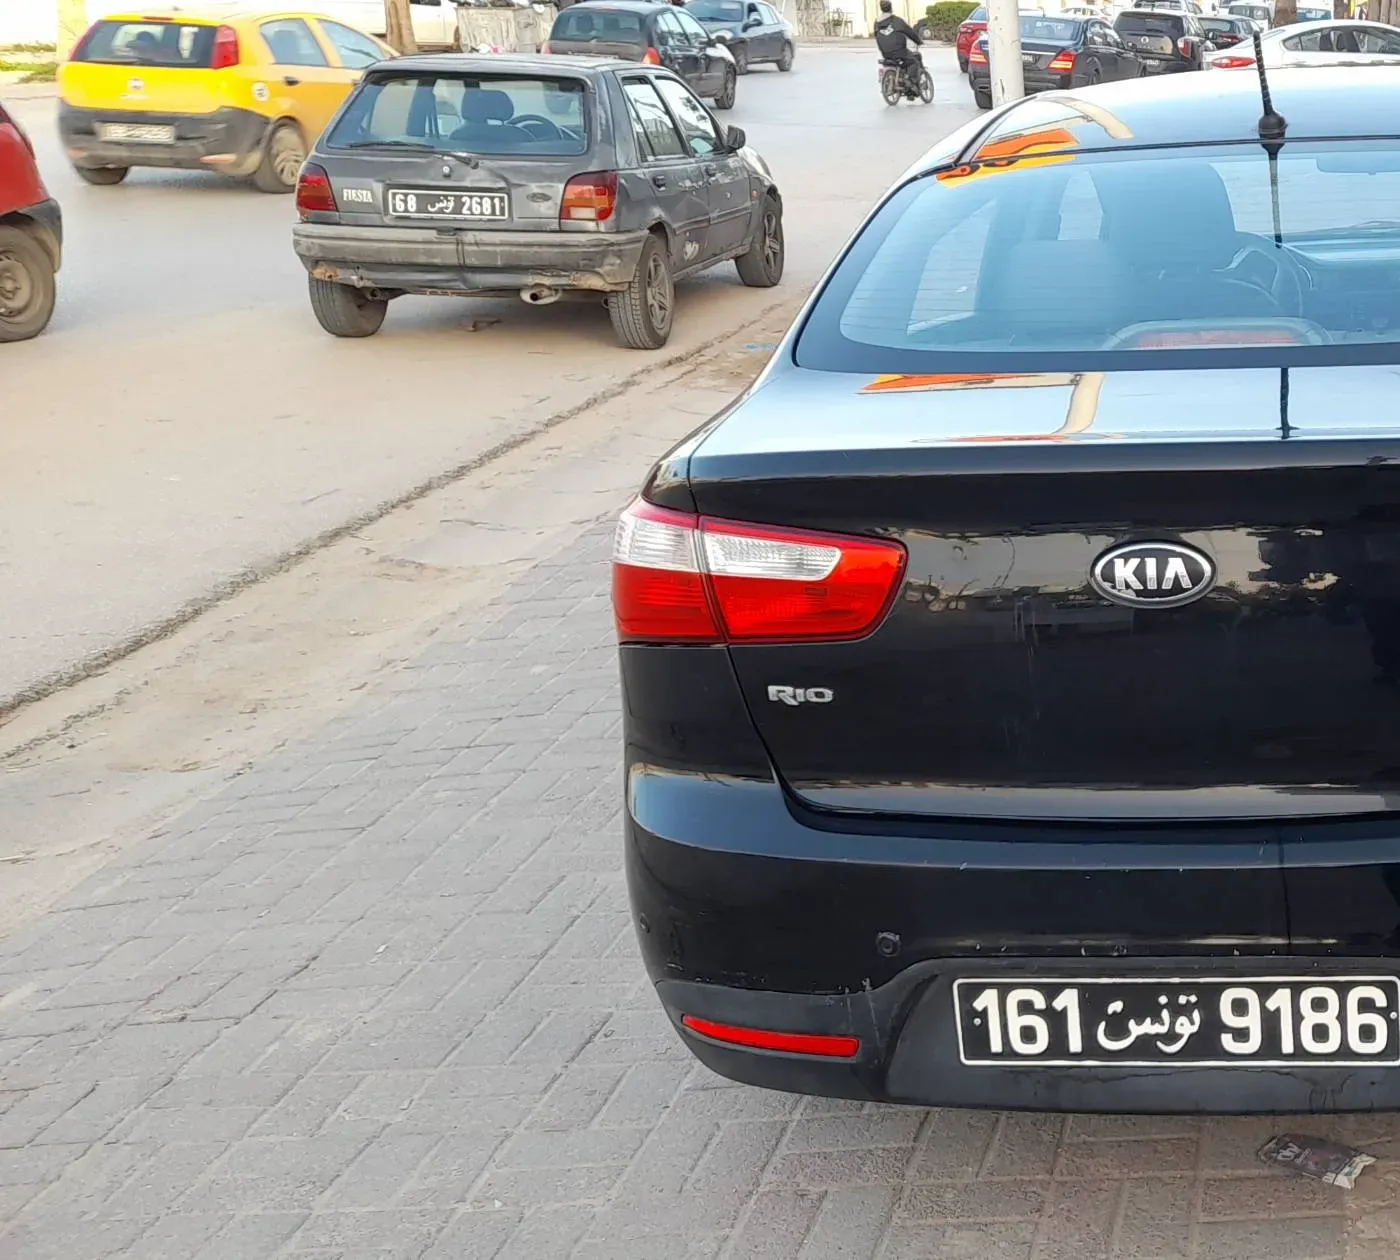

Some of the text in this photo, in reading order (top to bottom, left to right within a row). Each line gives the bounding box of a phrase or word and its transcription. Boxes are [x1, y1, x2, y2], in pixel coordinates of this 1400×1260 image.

[343, 188, 373, 203] FIESTA
[395, 193, 500, 215] 68 تونس 2681
[1113, 557, 1193, 590] KIA
[767, 684, 833, 706] RIO
[972, 985, 1389, 1056] 161 تونس 9186
